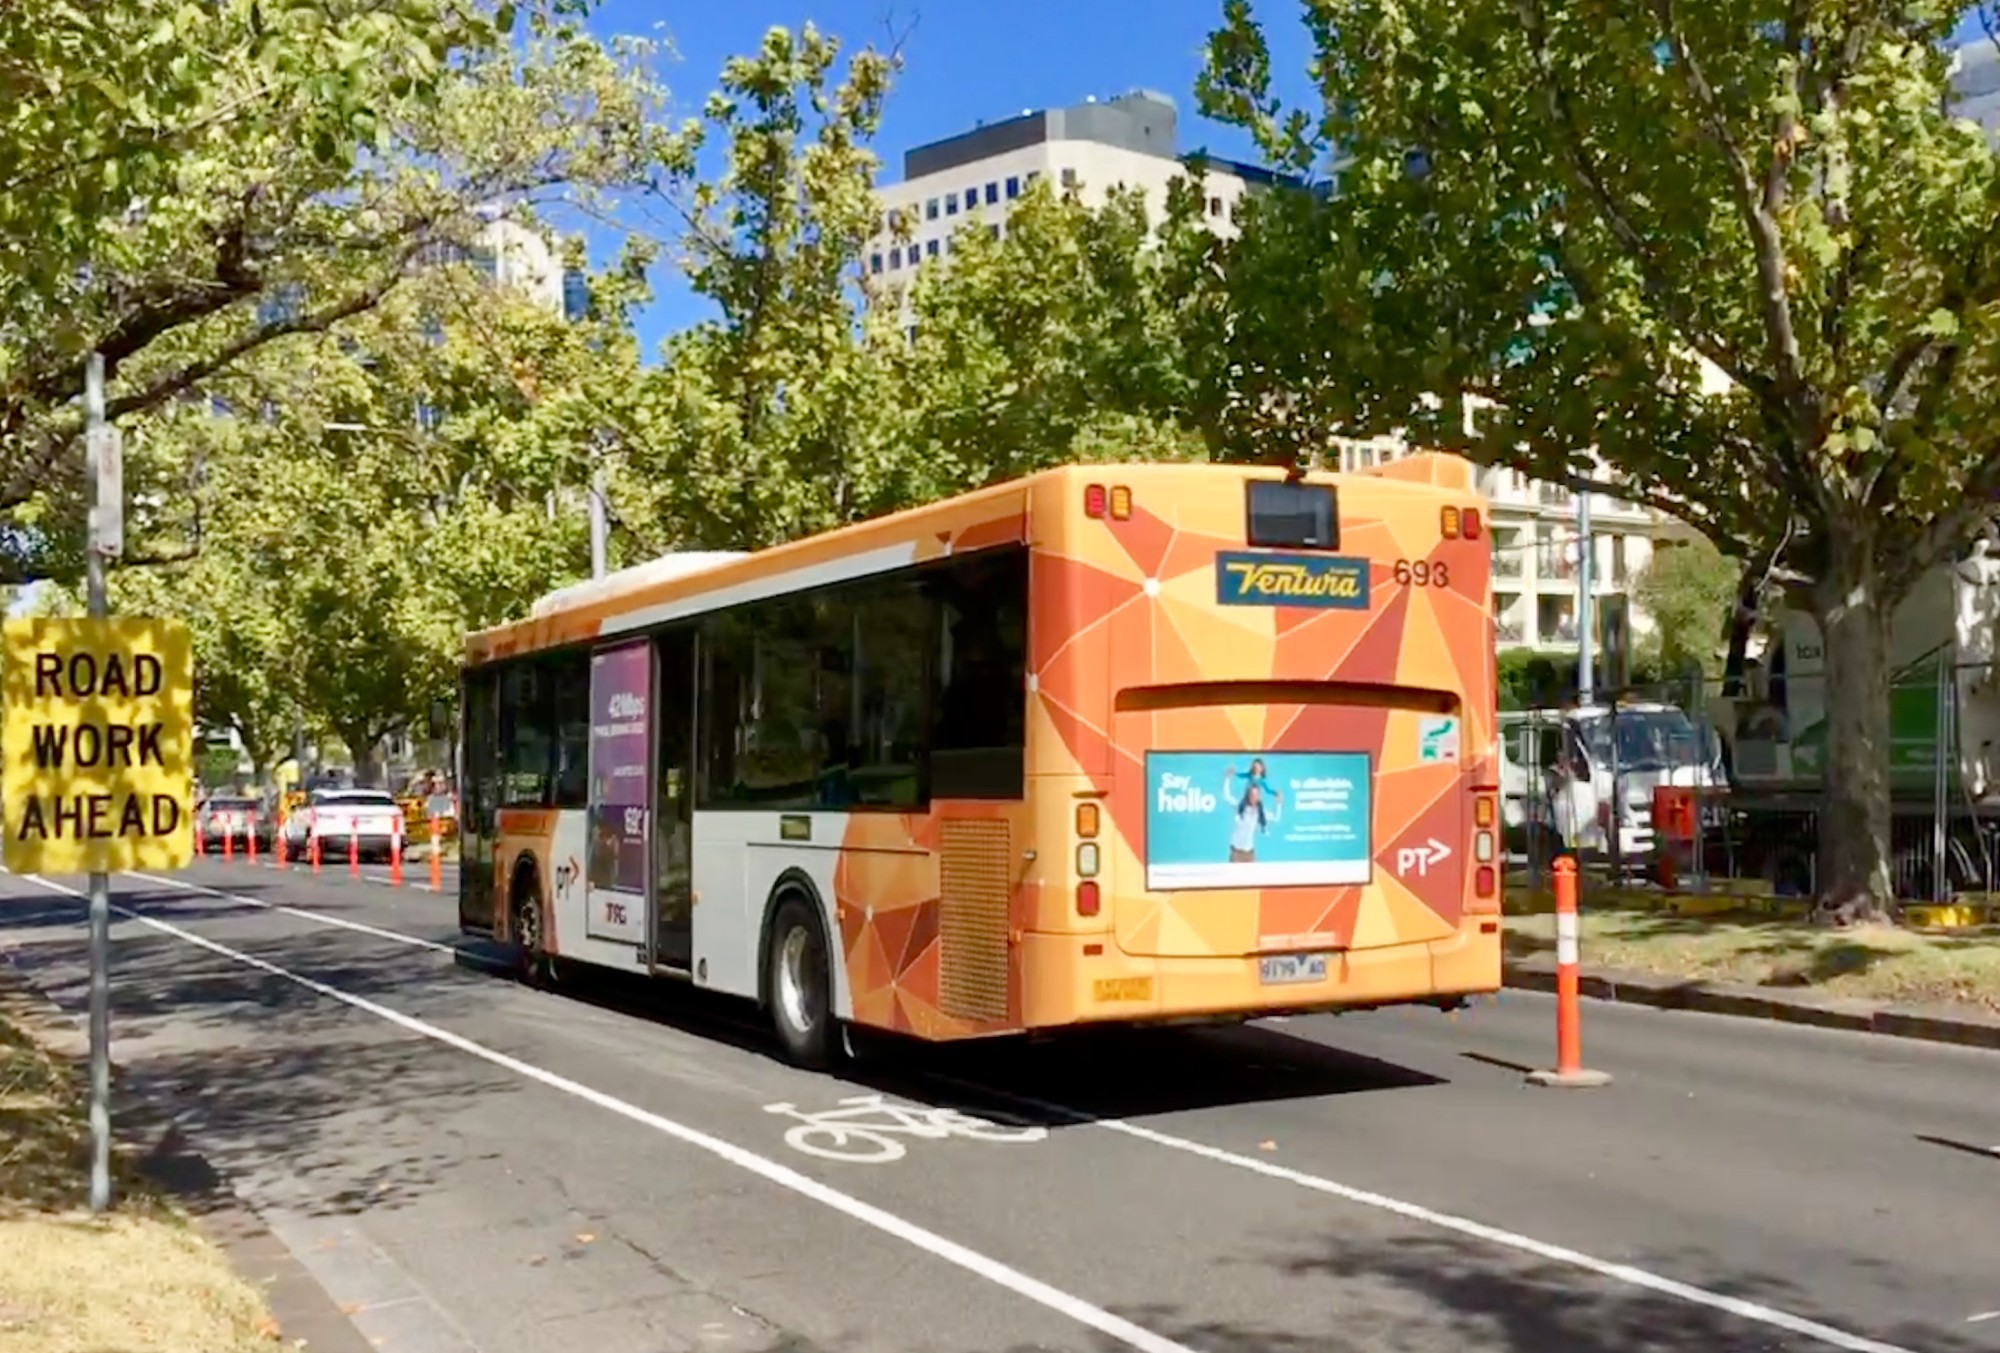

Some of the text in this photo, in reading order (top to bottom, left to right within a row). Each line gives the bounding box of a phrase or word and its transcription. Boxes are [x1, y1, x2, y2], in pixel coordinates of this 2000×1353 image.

[1226, 562, 1361, 598] Ventura
[1394, 559, 1449, 588] 693
[35, 652, 162, 697] ROAD
[32, 723, 164, 768] WORK
[1158, 787, 1217, 813] hello
[1161, 772, 1191, 792] Say
[18, 793, 180, 840] AHEAD
